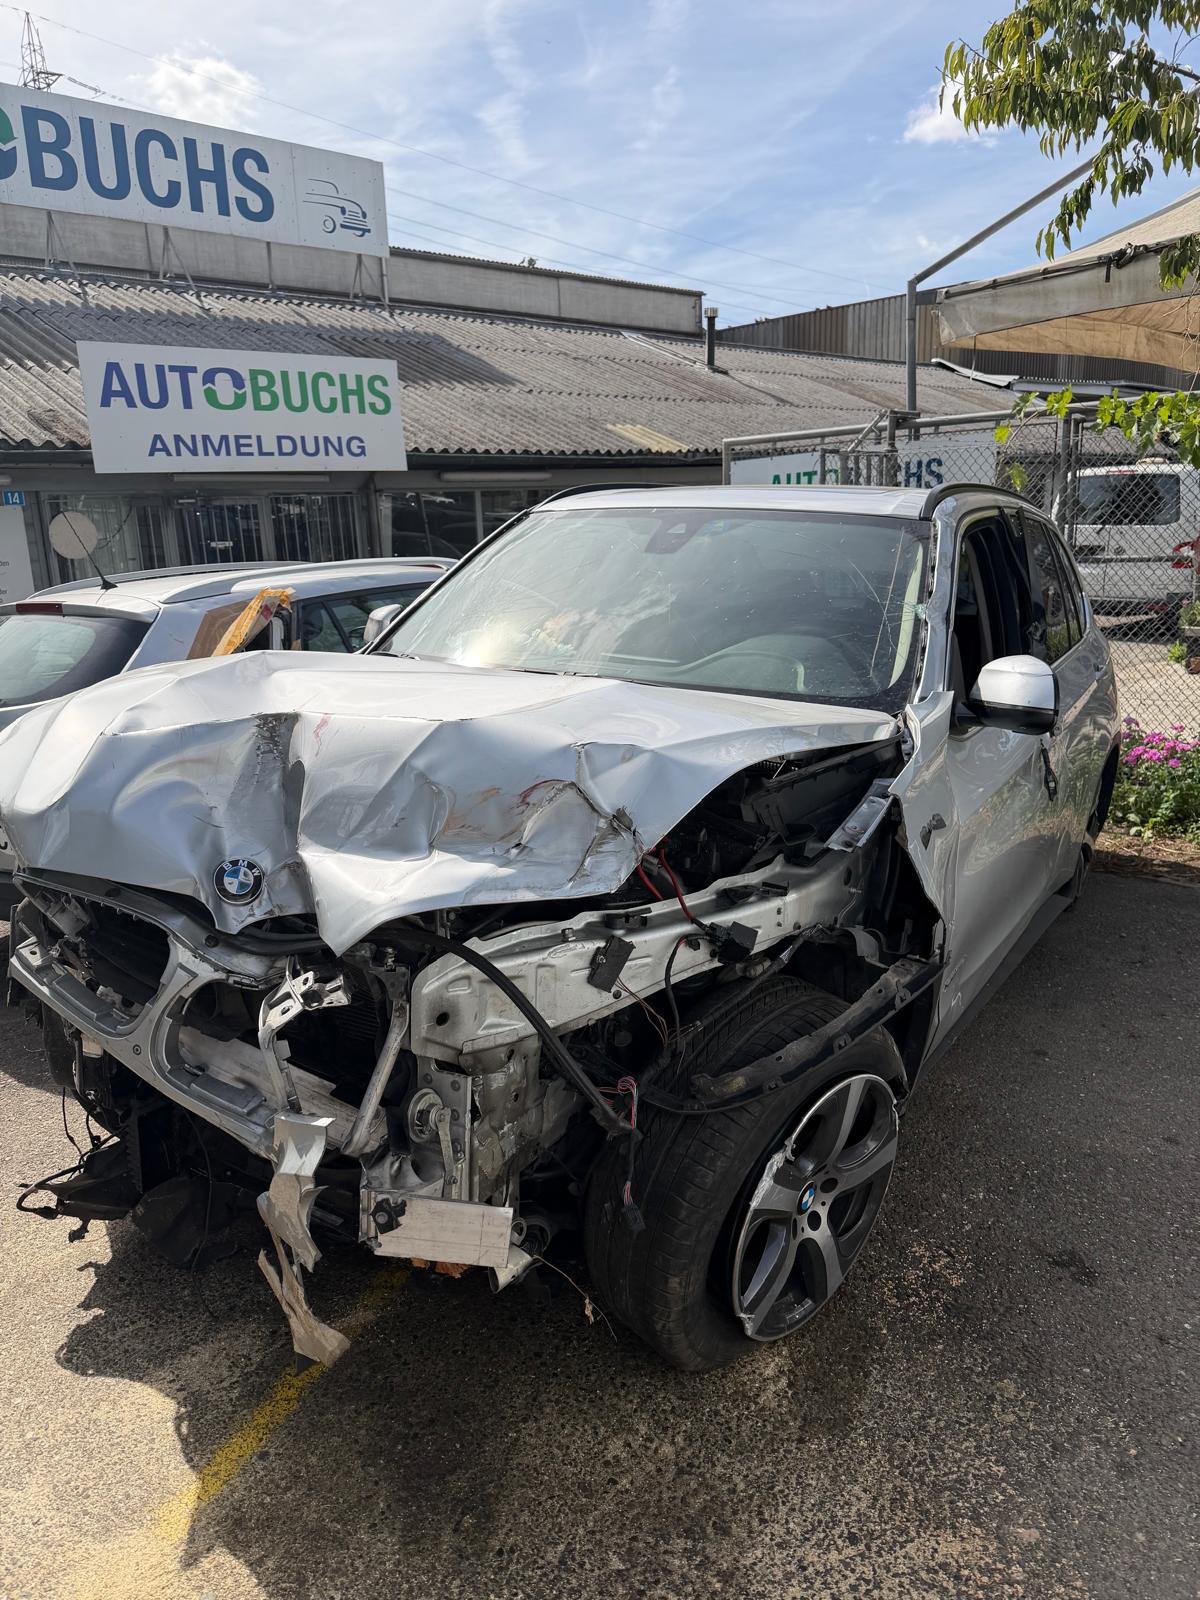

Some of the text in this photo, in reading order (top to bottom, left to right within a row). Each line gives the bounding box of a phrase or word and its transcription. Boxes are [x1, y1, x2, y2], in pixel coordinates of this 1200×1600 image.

[0, 104, 275, 223] BUCHS
[148, 433, 367, 457] ANMELDUNG
[7, 492, 20, 504] 14
[222, 859, 261, 877] BMW
